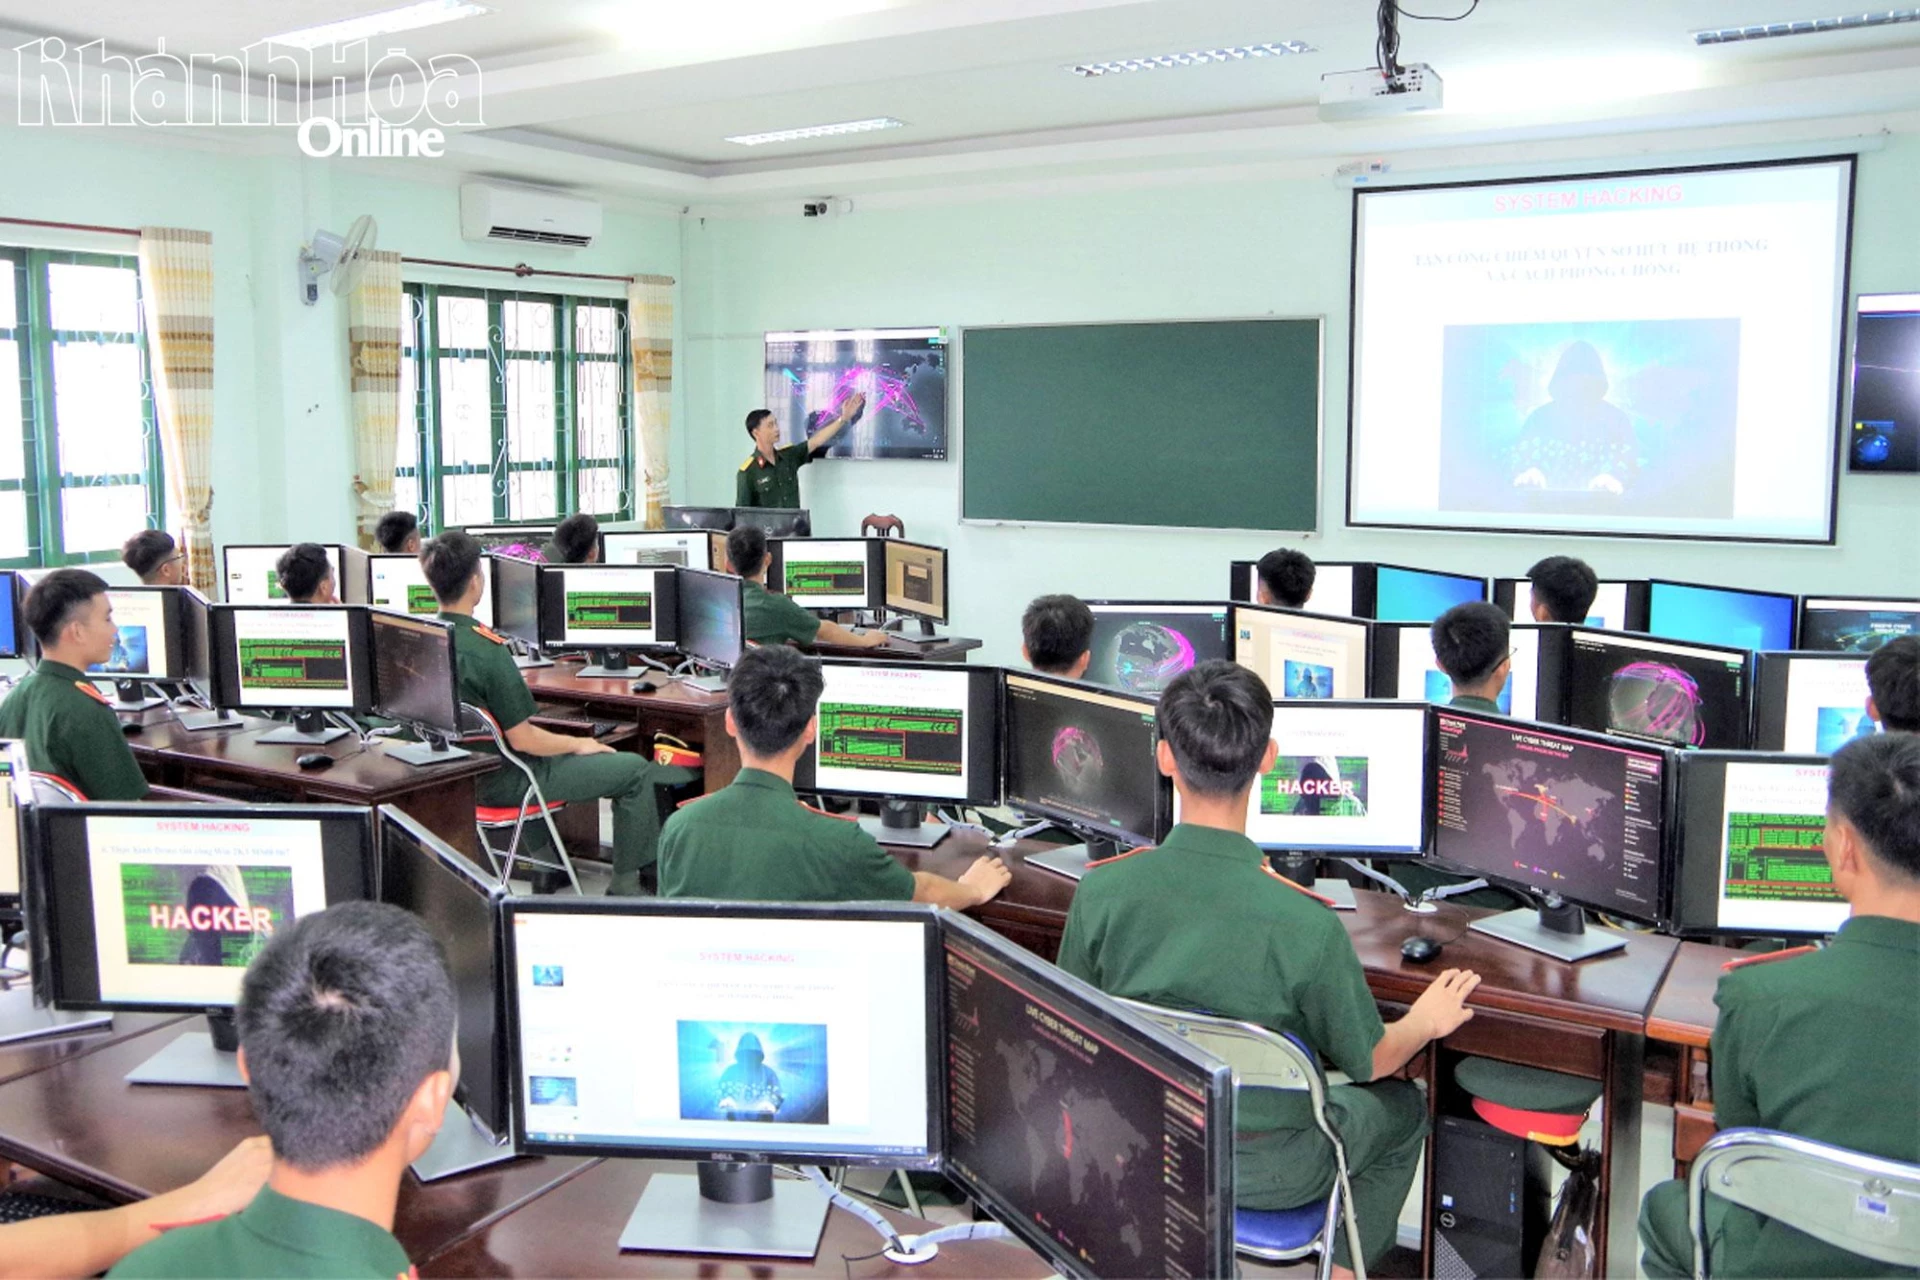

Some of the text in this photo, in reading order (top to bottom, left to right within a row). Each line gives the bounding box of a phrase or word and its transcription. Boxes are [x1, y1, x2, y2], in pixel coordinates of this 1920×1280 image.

[1494, 183, 1683, 212] SYSTEM HACKING
[1277, 779, 1355, 796] HACKER
[156, 821, 250, 833] SYSTEM HACKING
[150, 904, 273, 931] HACKER
[699, 951, 742, 962] SYSTEM
[1039, 1011, 1059, 1031] CYBER
[1058, 1022, 1083, 1047] THREAT
